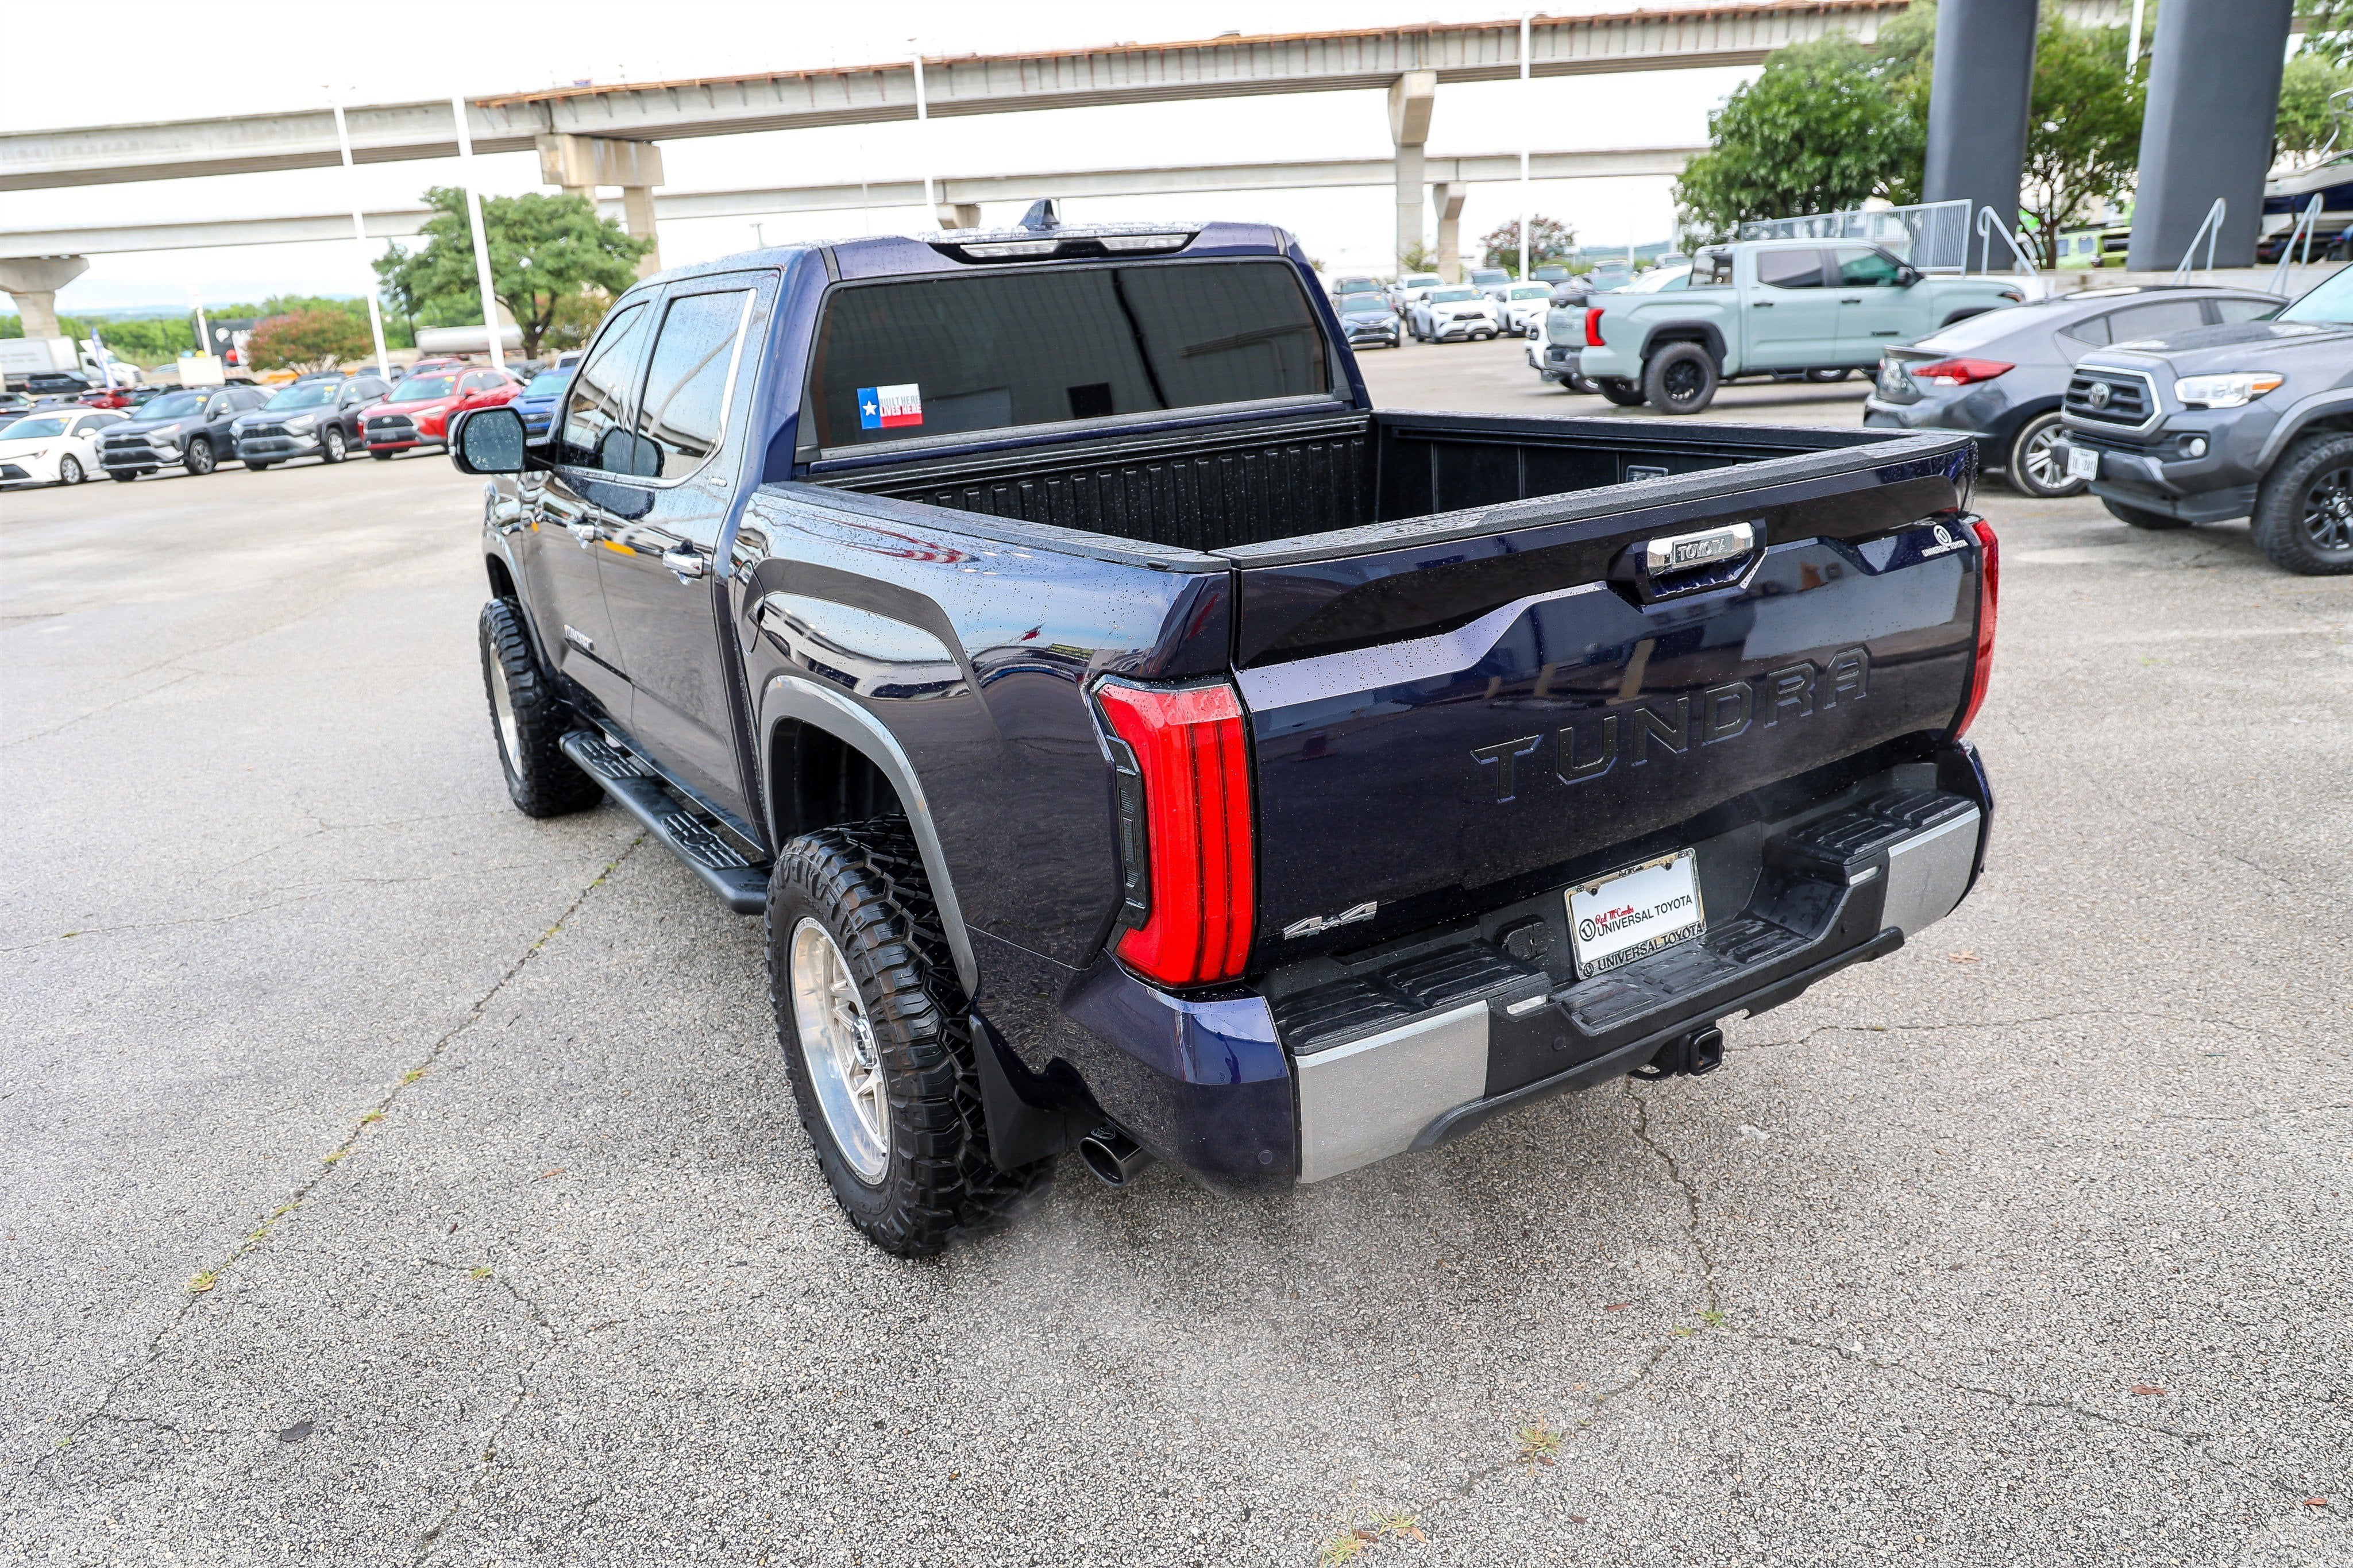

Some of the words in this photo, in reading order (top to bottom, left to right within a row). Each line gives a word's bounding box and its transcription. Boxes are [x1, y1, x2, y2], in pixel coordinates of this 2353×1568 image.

[880, 397, 899, 406] BUILT
[880, 405, 901, 416] LIVES
[1677, 538, 1728, 561] TOYOTA
[1950, 539, 1969, 550] TOYOTA
[1469, 642, 1872, 804] TUNDRA
[1595, 913, 1607, 926] Red
[1597, 909, 1654, 937] UNIVERSAL
[1654, 894, 1693, 916] TOYOTA
[1597, 939, 1661, 971] UNIVERSAL
[1661, 924, 1704, 947] TOYOTA
